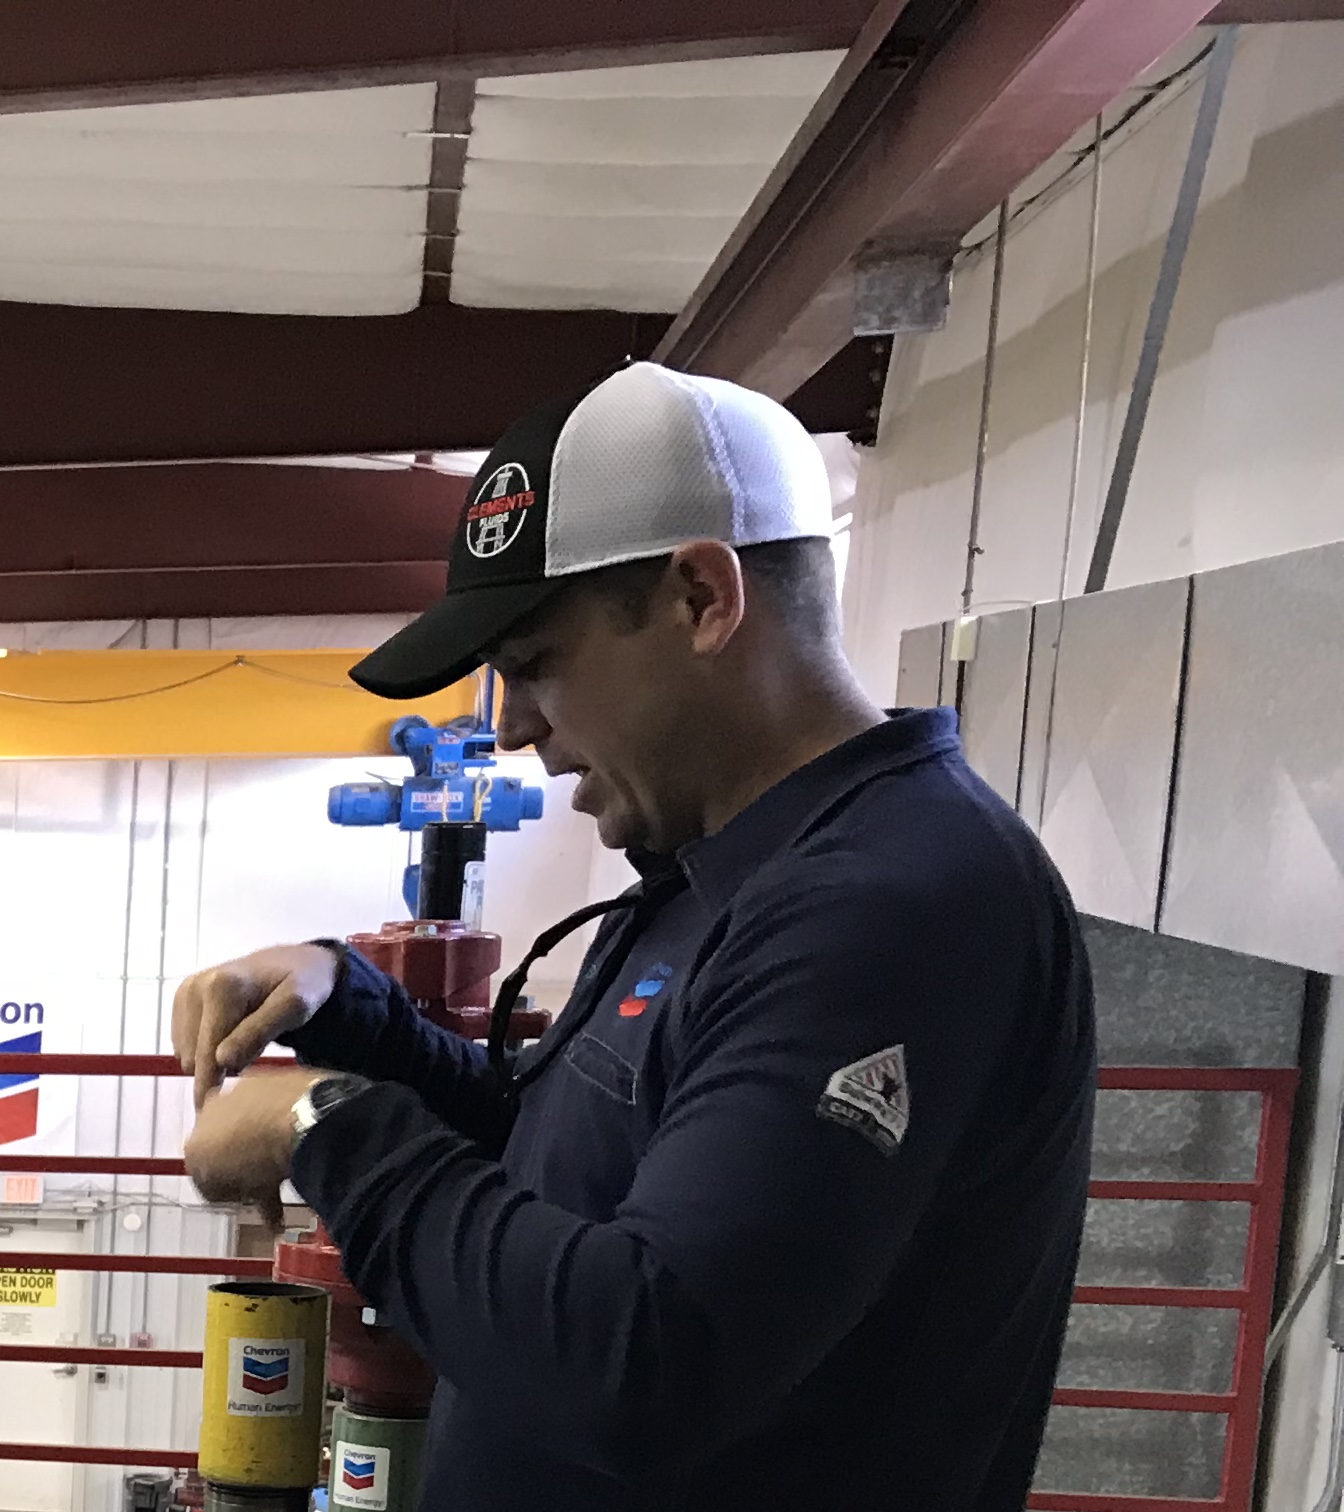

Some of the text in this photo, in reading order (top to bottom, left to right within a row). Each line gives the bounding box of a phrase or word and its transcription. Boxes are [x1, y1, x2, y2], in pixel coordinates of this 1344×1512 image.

[20, 1276, 54, 1290] DOOR
[243, 1345, 290, 1356] Chevron
[228, 1401, 302, 1414] Human Energy
